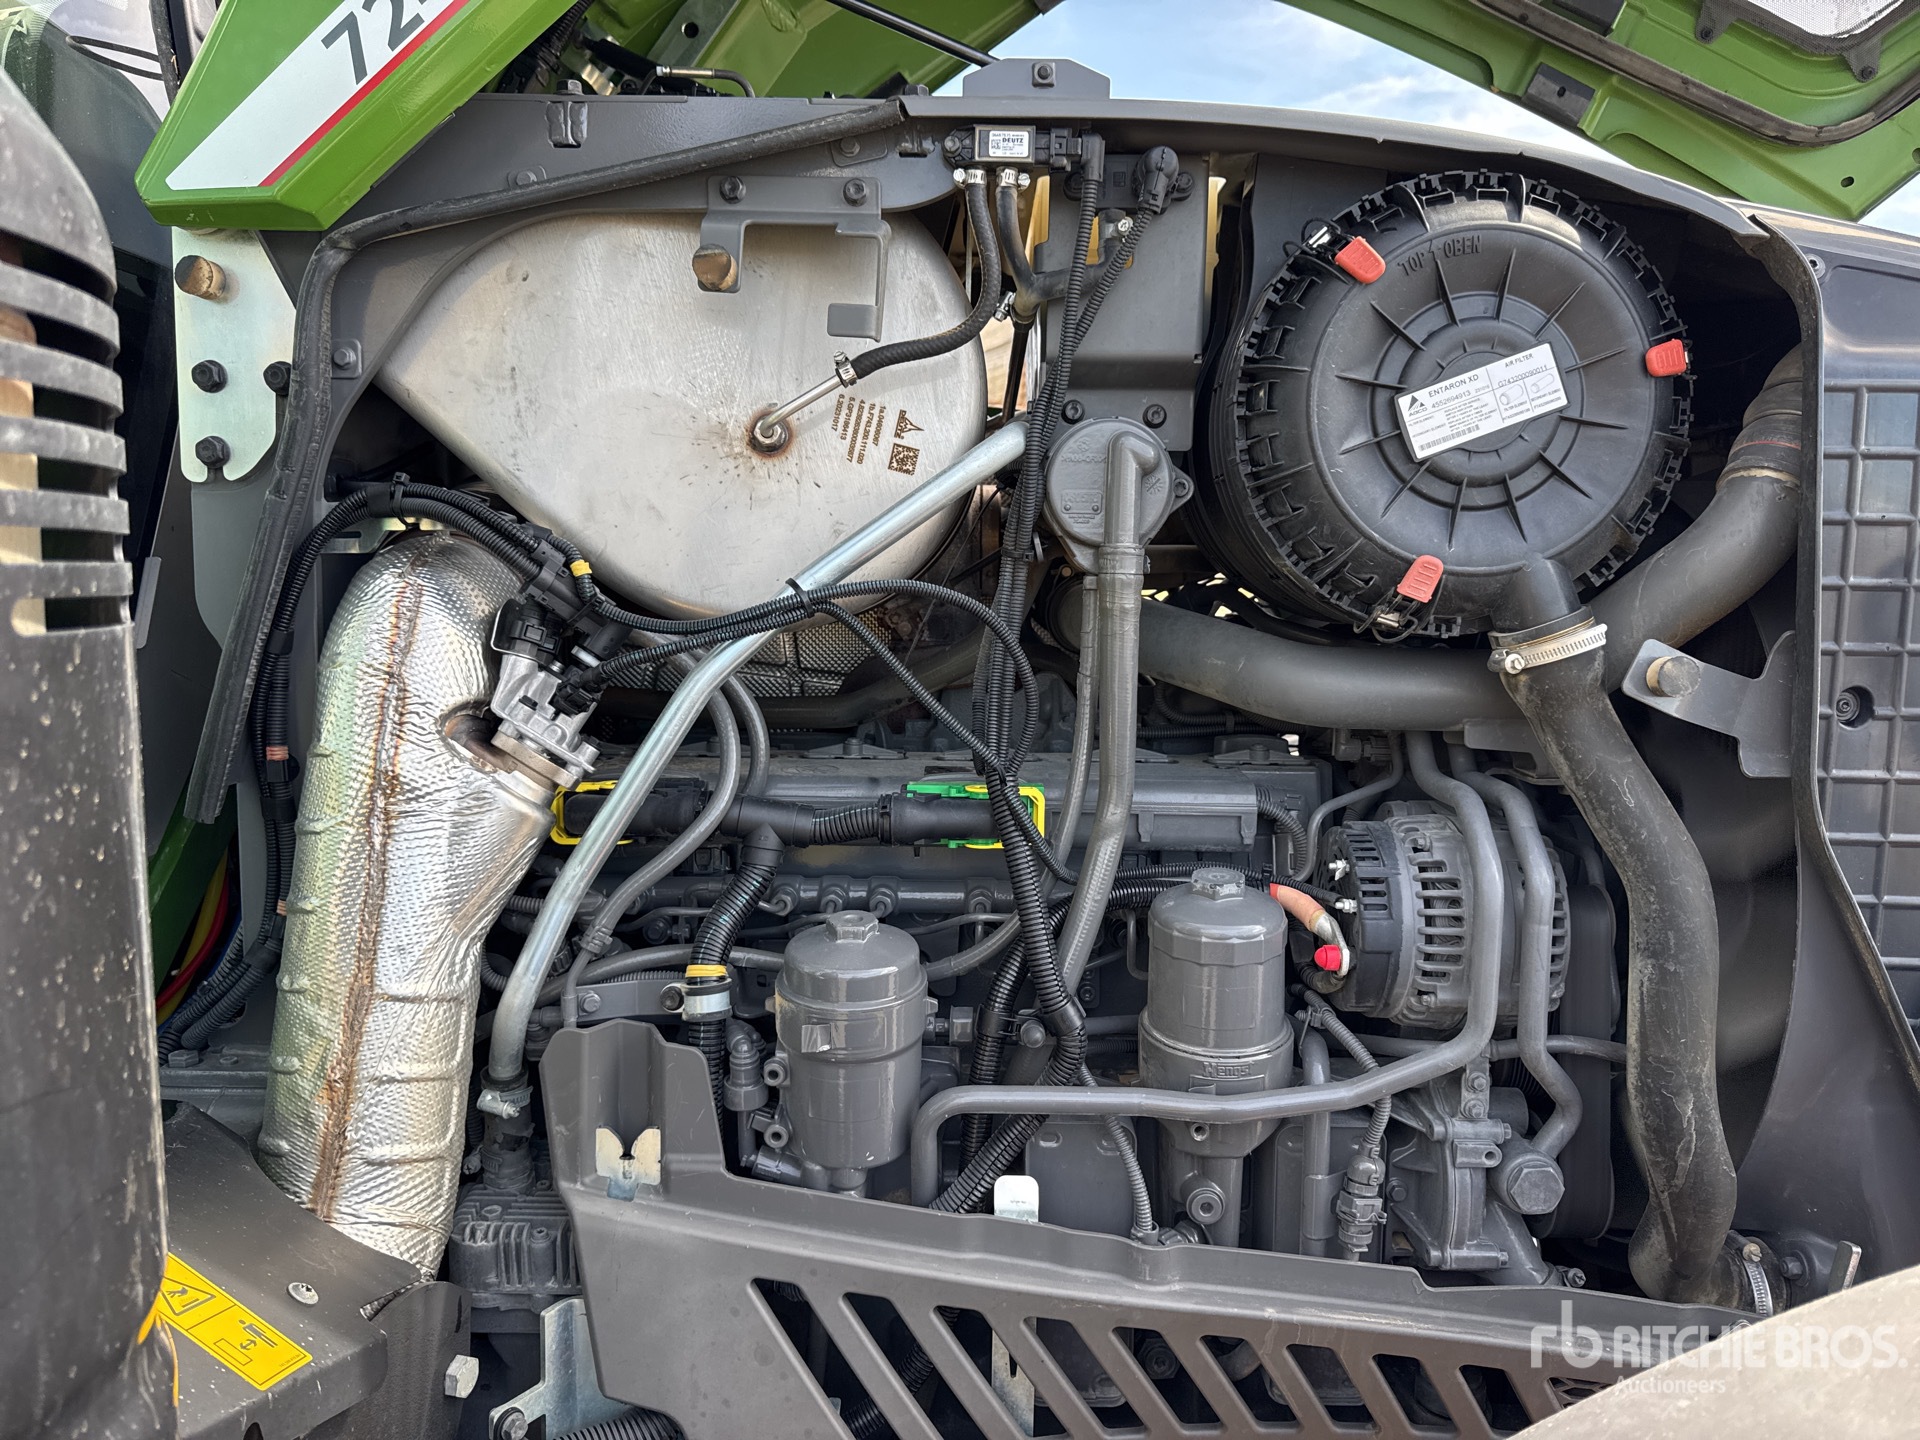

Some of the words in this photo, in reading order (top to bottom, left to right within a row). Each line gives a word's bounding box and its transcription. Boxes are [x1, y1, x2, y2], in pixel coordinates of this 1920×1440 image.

[321, 0, 427, 85] 72
[1397, 252, 1425, 276] TOP
[1443, 235, 1481, 258] OBEN
[1504, 360, 1514, 368] AIR
[1514, 353, 1534, 364] FILTER
[1428, 379, 1467, 398] ENTARON
[1468, 374, 1479, 383] XD
[1409, 407, 1428, 417] AGCO
